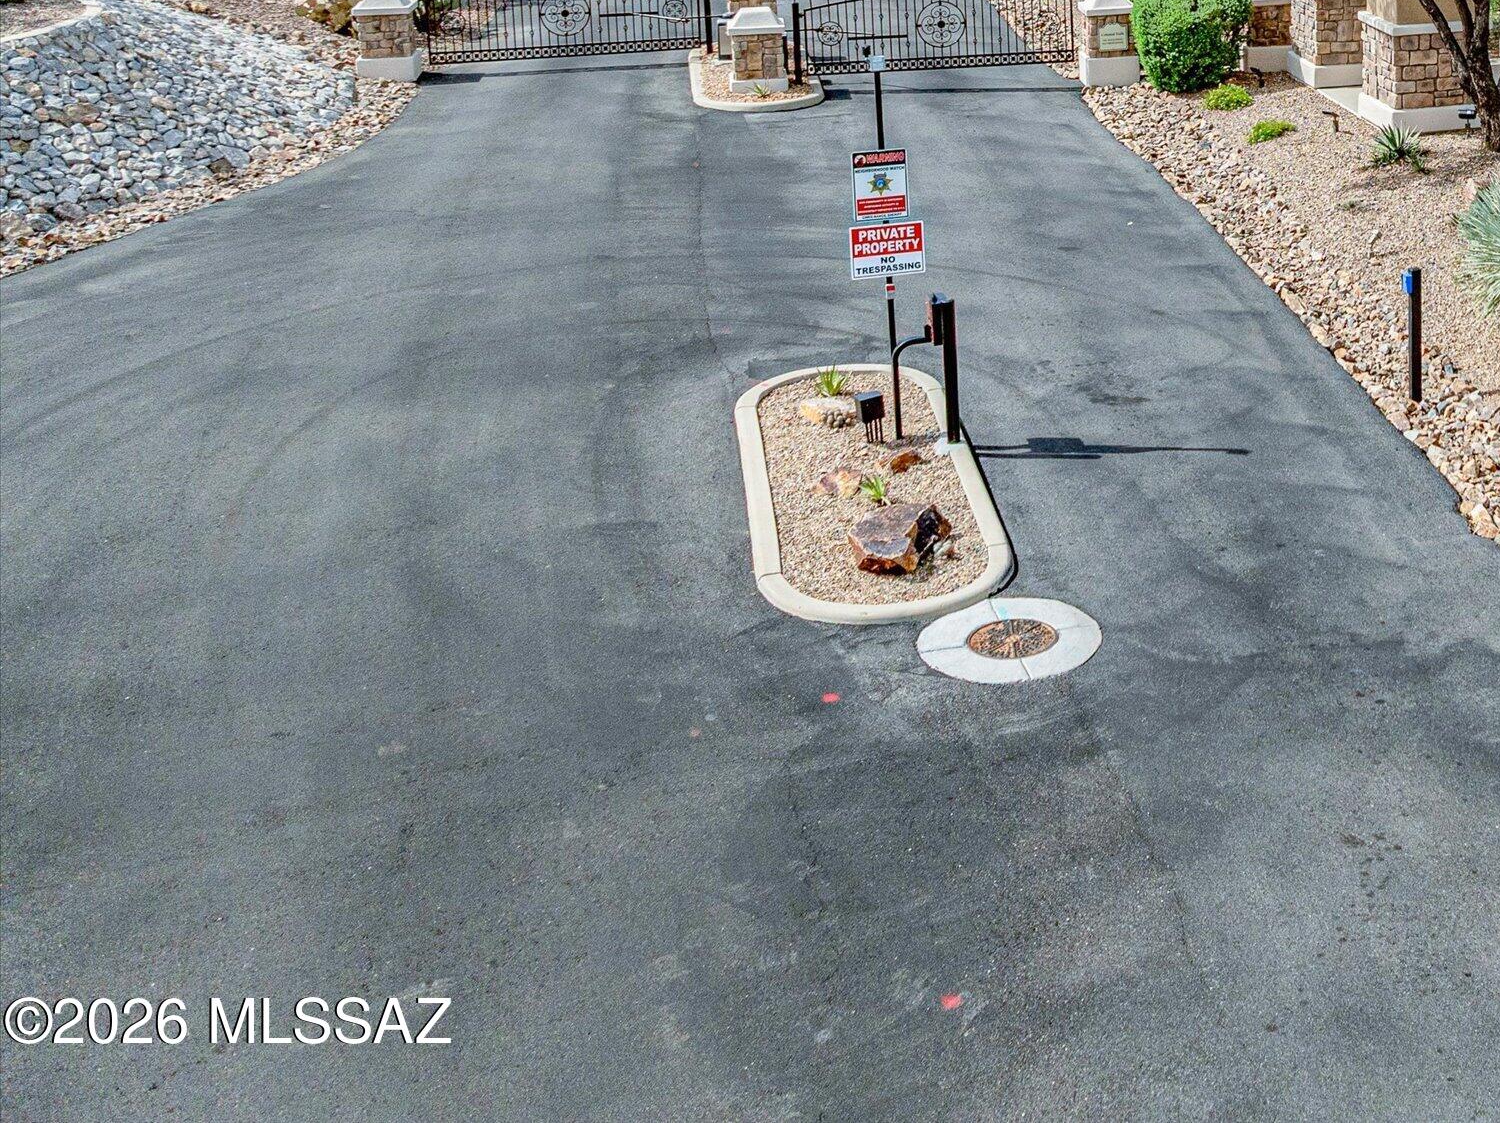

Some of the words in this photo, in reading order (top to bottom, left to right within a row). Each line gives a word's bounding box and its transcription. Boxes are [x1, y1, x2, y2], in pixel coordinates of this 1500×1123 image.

[865, 151, 905, 164] WARNING
[858, 226, 915, 242] PRIVATE
[854, 238, 920, 255] PROPERTY
[881, 256, 895, 264] NO
[856, 262, 921, 275] TRESPASSING
